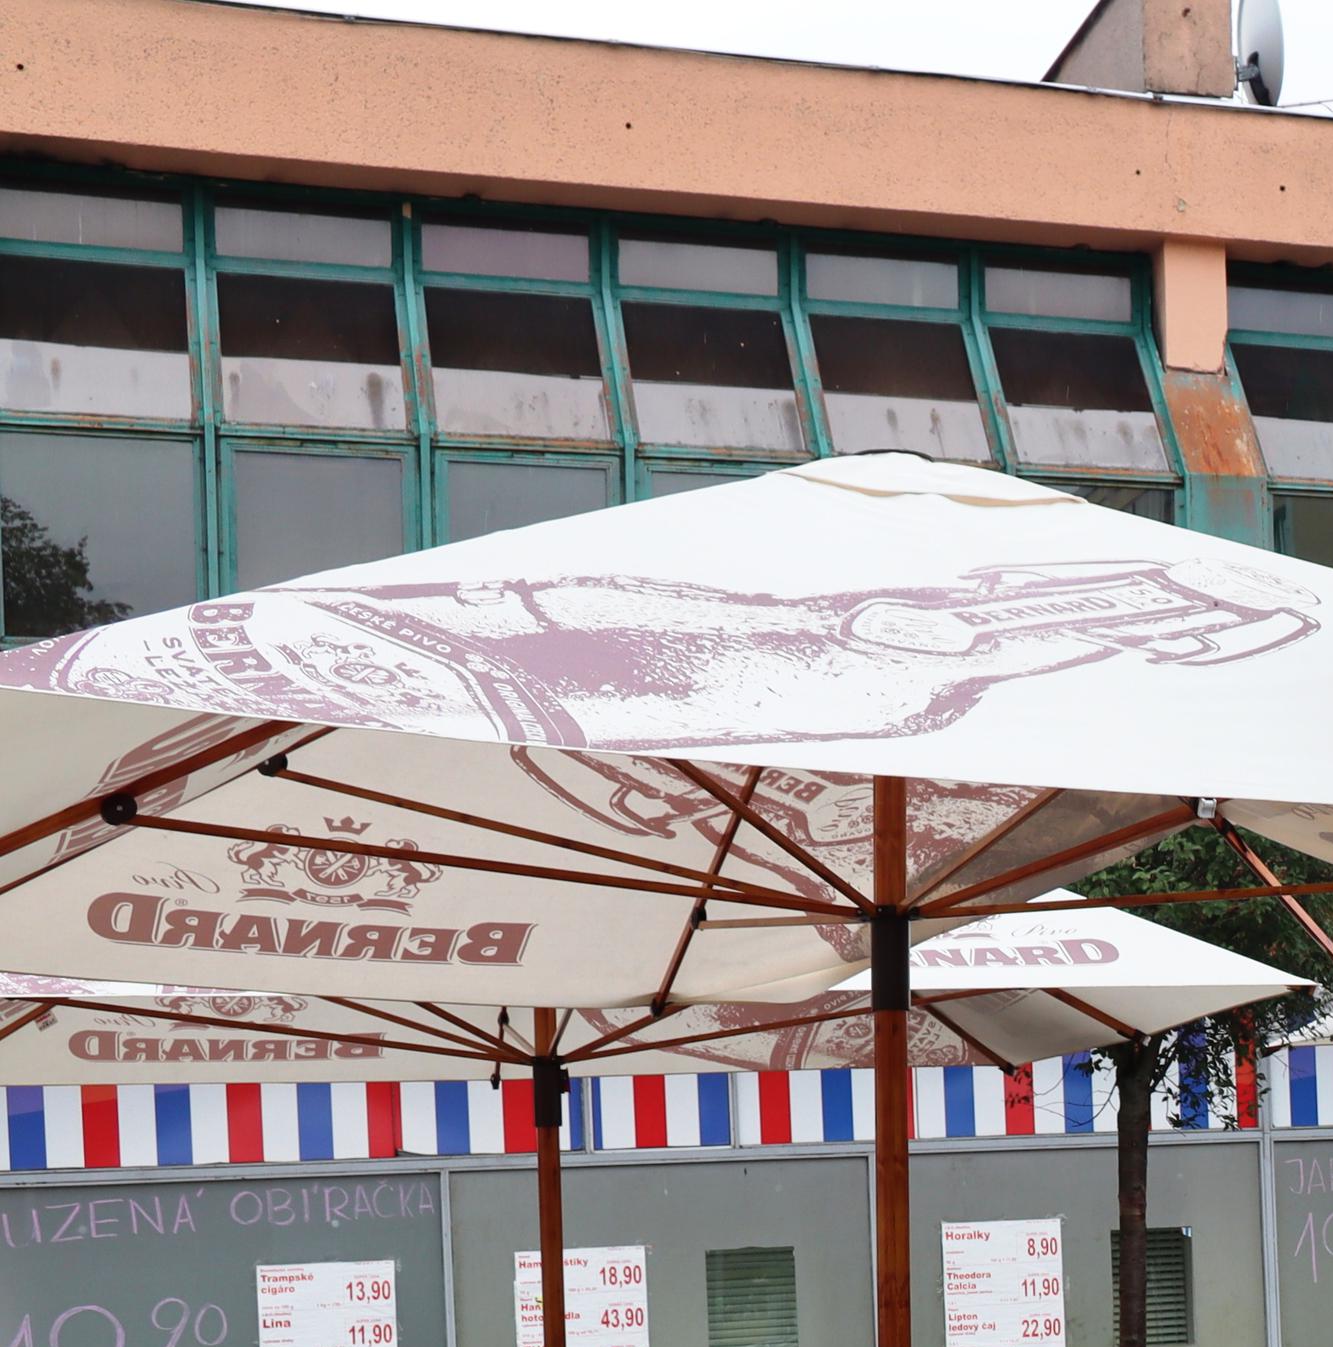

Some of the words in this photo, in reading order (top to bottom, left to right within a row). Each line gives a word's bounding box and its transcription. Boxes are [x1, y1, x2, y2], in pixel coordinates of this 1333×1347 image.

[952, 596, 1118, 627] BERNARD
[399, 627, 451, 653] PIVO
[910, 938, 1120, 967] NARD
[1, 1187, 206, 1248] UZENÁ
[945, 1231, 990, 1241] Horalky
[1027, 1237, 1058, 1259] 8,90
[518, 1260, 543, 1269] Ham
[946, 1271, 991, 1280] Theodora
[260, 1272, 314, 1283] Trampské
[600, 1265, 642, 1288] 18,90
[947, 1282, 977, 1291] Calcia
[261, 1285, 295, 1295] cigáro
[346, 1280, 391, 1304] 13,90
[1021, 1277, 1059, 1300] 11,90
[521, 1313, 544, 1322] hoto
[601, 1307, 645, 1331] 43,90
[948, 1313, 978, 1322] Lipton
[348, 1323, 393, 1347] 11,90
[1022, 1318, 1061, 1340] 22,90
